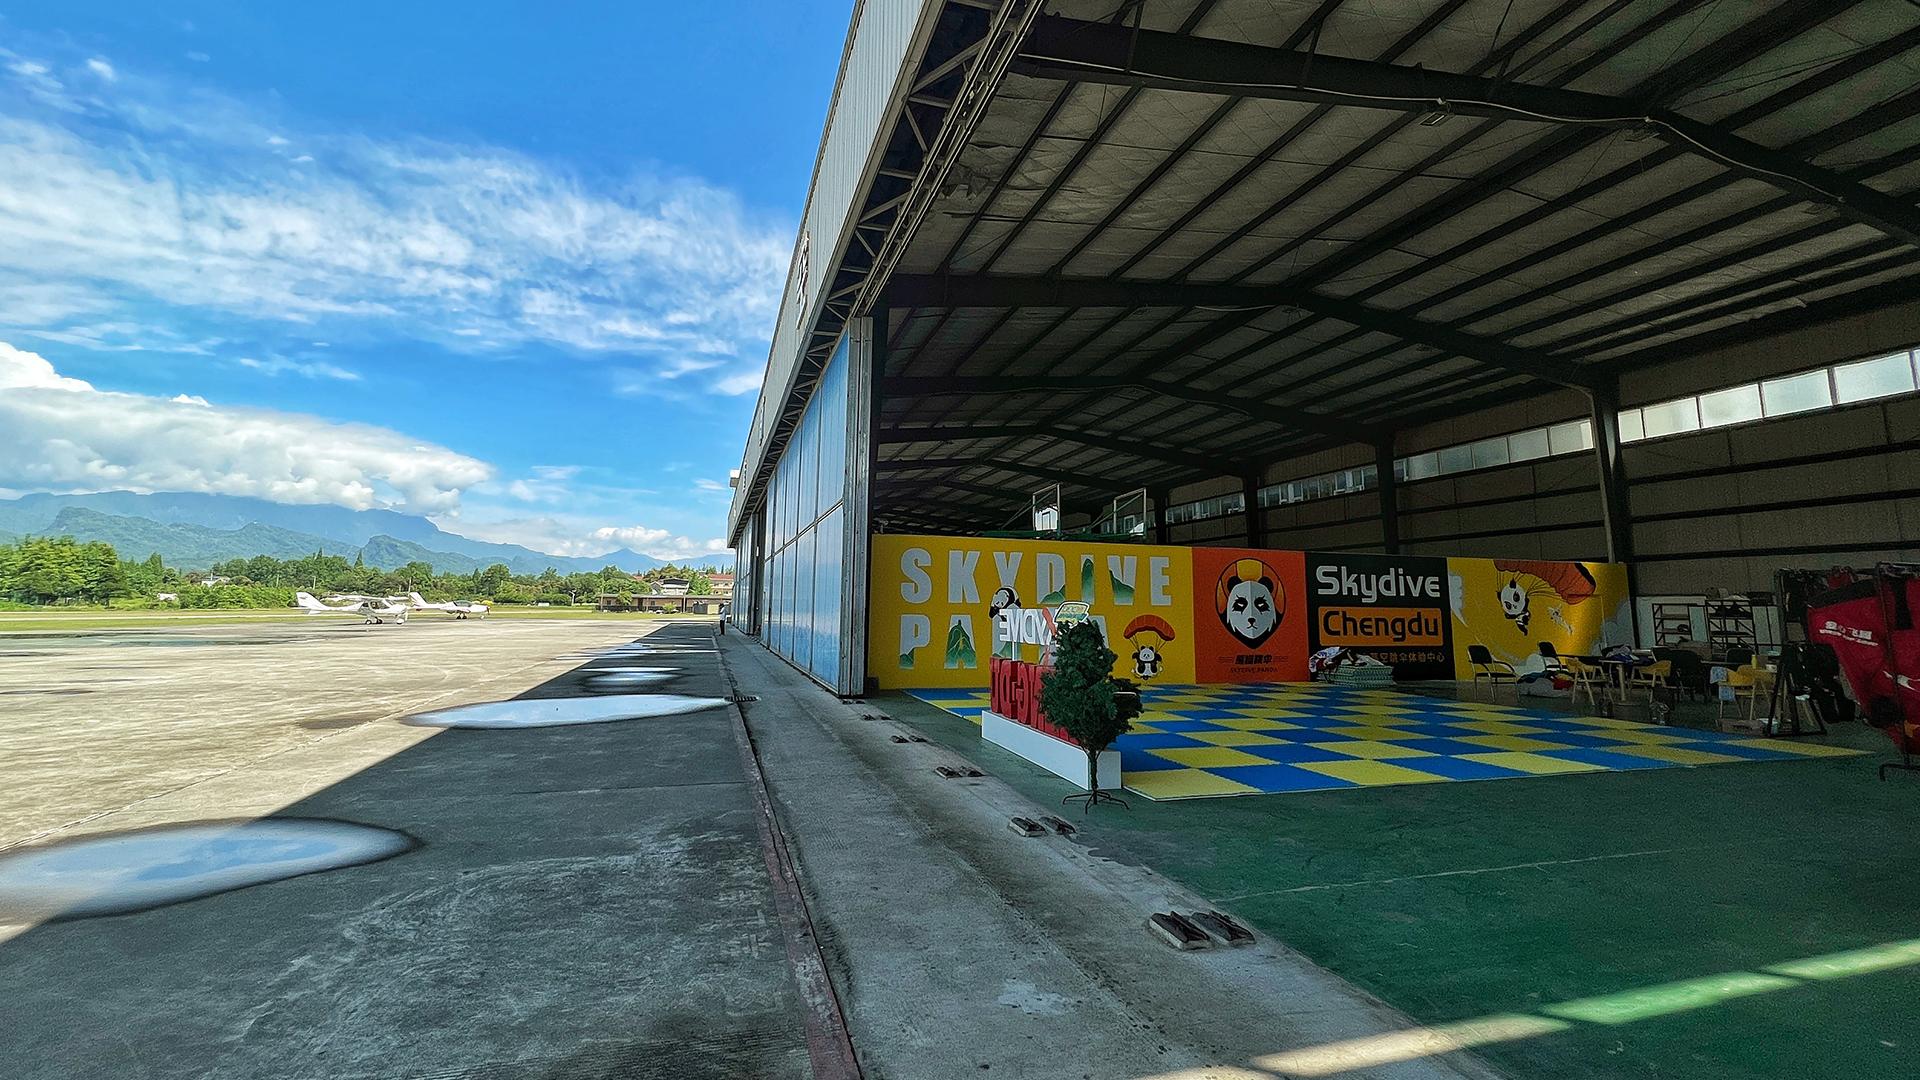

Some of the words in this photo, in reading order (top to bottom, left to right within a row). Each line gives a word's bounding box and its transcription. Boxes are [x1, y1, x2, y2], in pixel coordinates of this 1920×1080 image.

[900, 547, 1172, 606] SKYDIVE
[1315, 565, 1441, 602] Skydive
[1323, 611, 1439, 642] Chengdu
